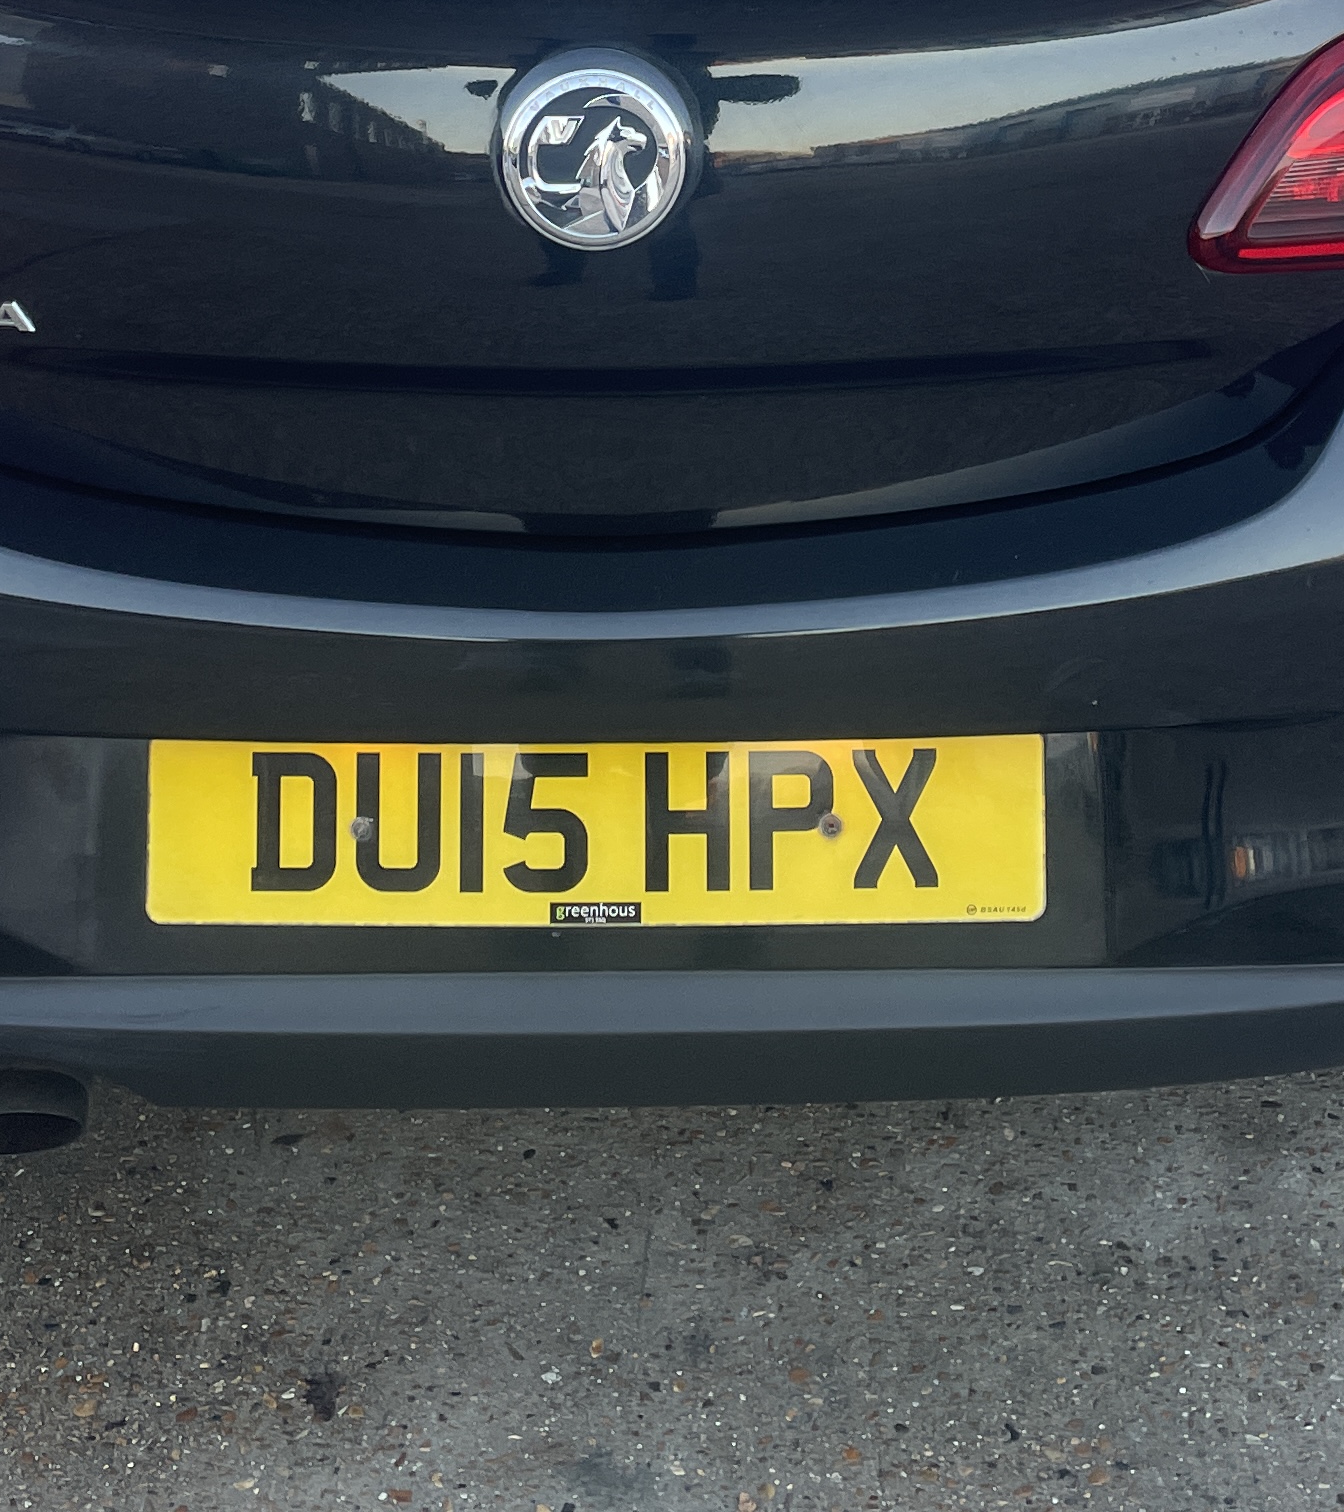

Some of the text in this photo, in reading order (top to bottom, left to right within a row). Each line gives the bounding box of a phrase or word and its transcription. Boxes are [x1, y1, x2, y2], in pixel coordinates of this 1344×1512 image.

[529, 77, 654, 112] VAUXHALL
[251, 748, 940, 893] DU15 HPX
[556, 902, 636, 921] greenhous
